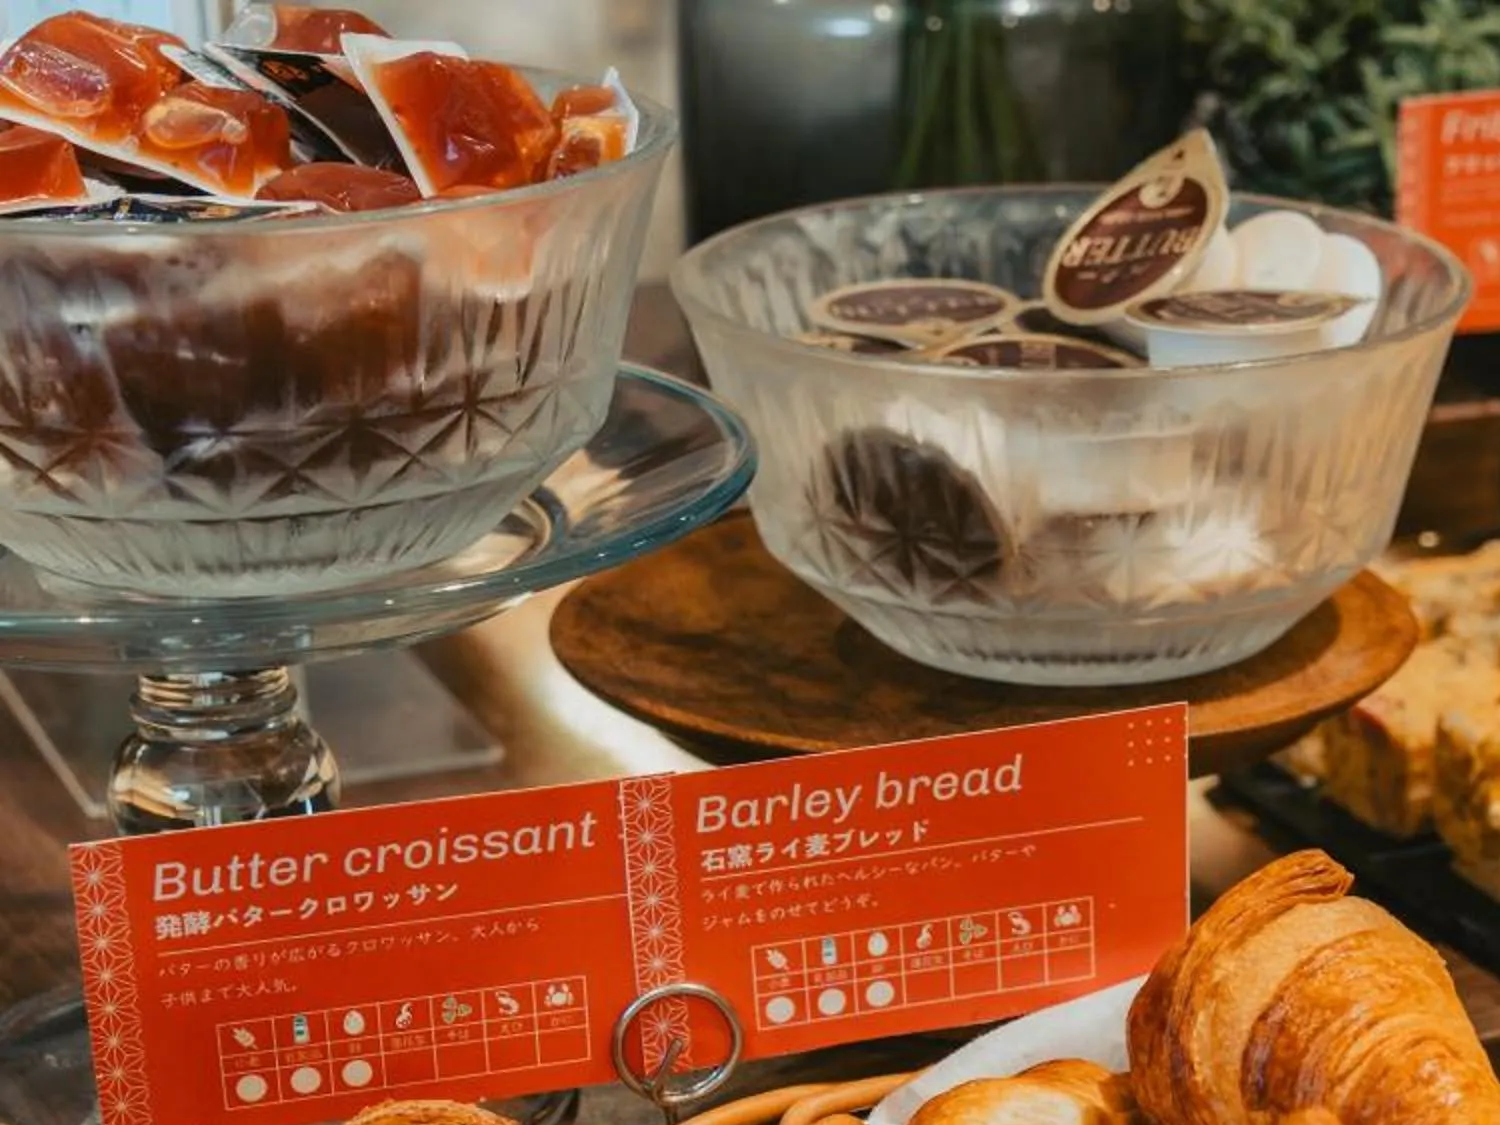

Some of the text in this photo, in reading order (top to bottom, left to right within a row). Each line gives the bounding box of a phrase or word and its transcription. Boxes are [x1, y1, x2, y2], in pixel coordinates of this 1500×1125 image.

[696, 753, 1023, 833] Barley bread
[153, 811, 598, 902] Butter croissant
[155, 883, 459, 940] 発酵バタークロワッサン
